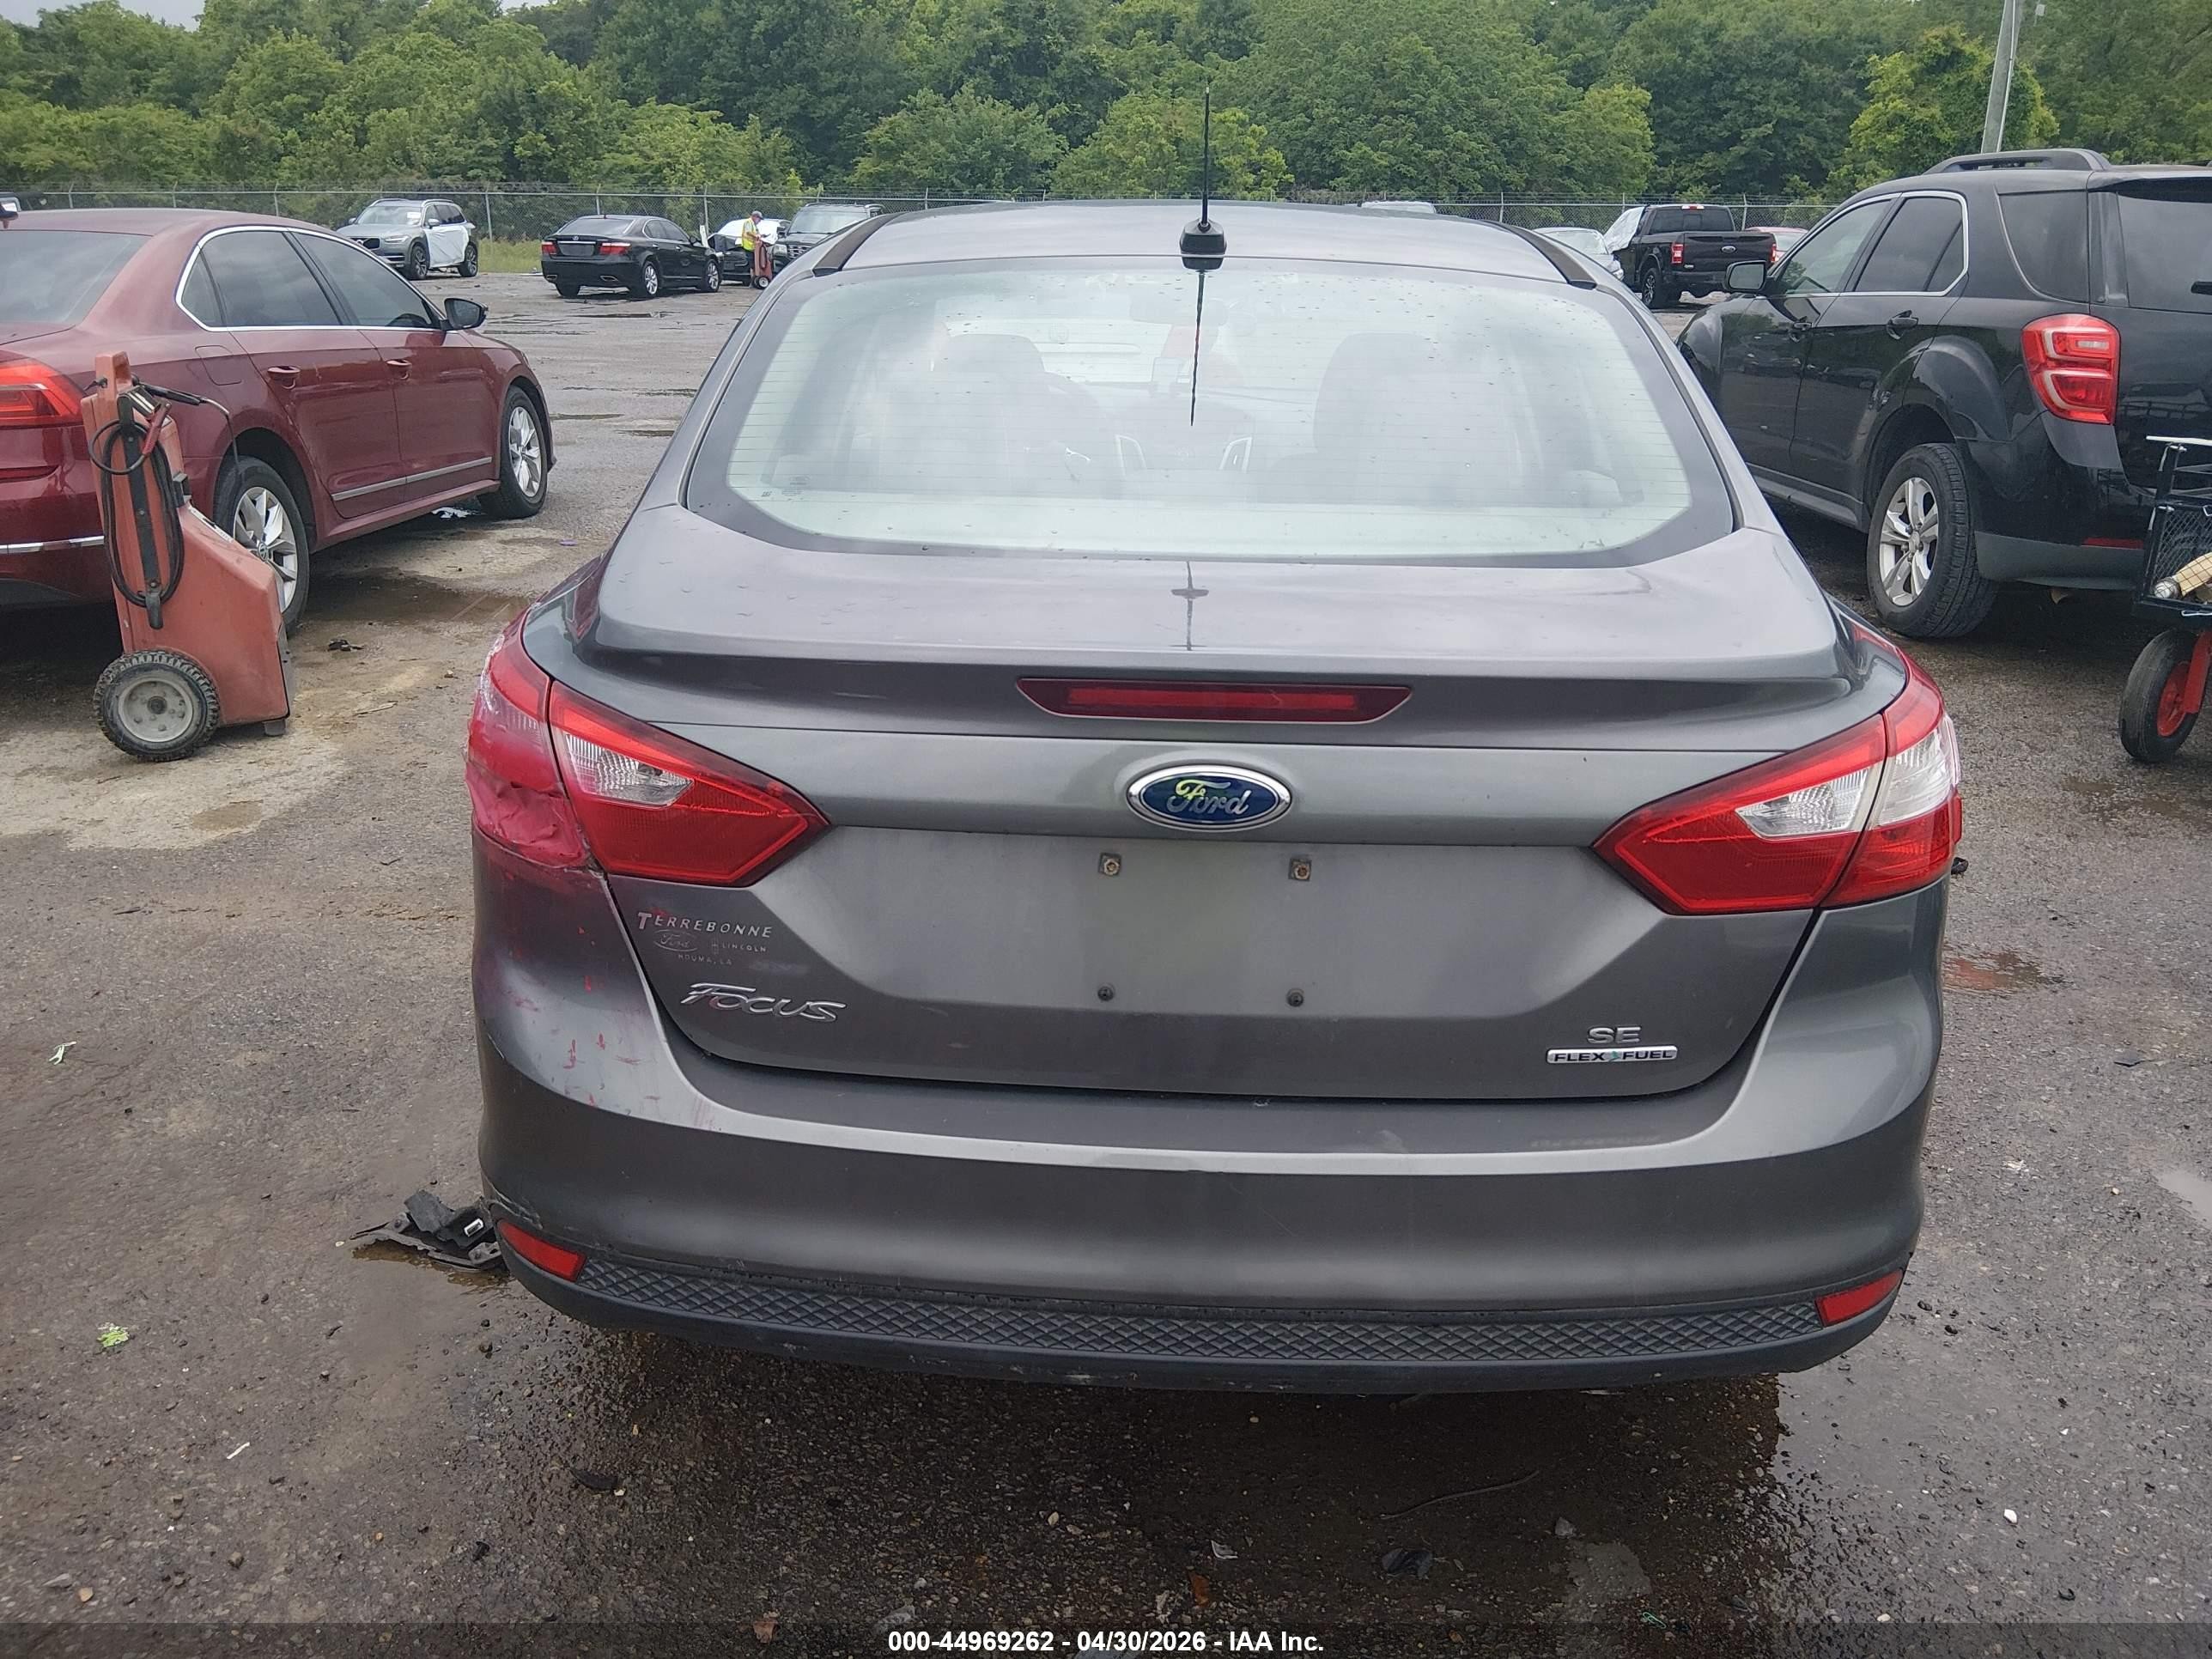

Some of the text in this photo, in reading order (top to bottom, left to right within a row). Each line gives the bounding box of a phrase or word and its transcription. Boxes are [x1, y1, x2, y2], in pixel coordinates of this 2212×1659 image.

[1166, 779, 1252, 815] Ford
[638, 912, 772, 938] TERREBONNE
[722, 942, 767, 952] LINCOLN
[1587, 1026, 1642, 1044] SE
[1554, 1049, 1674, 1062] FLEX FUEL
